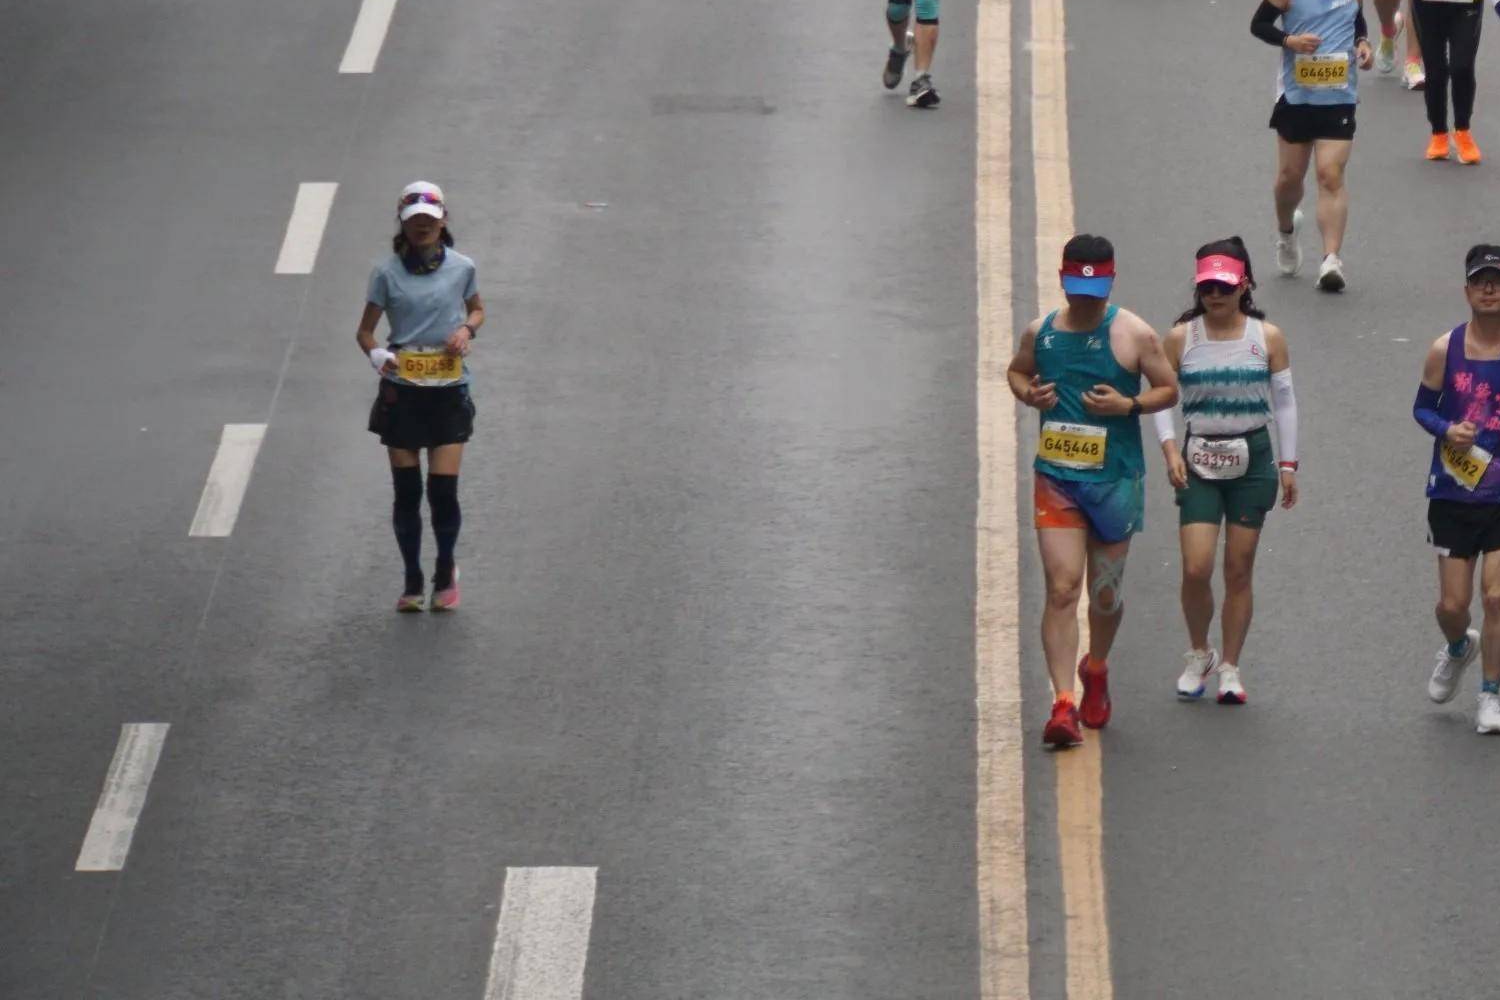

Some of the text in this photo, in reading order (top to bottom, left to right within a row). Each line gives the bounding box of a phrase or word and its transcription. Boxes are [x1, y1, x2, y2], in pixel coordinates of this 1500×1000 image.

[1300, 65, 1345, 78] G44562
[1043, 437, 1099, 456] G45448
[1191, 451, 1241, 467] G33991
